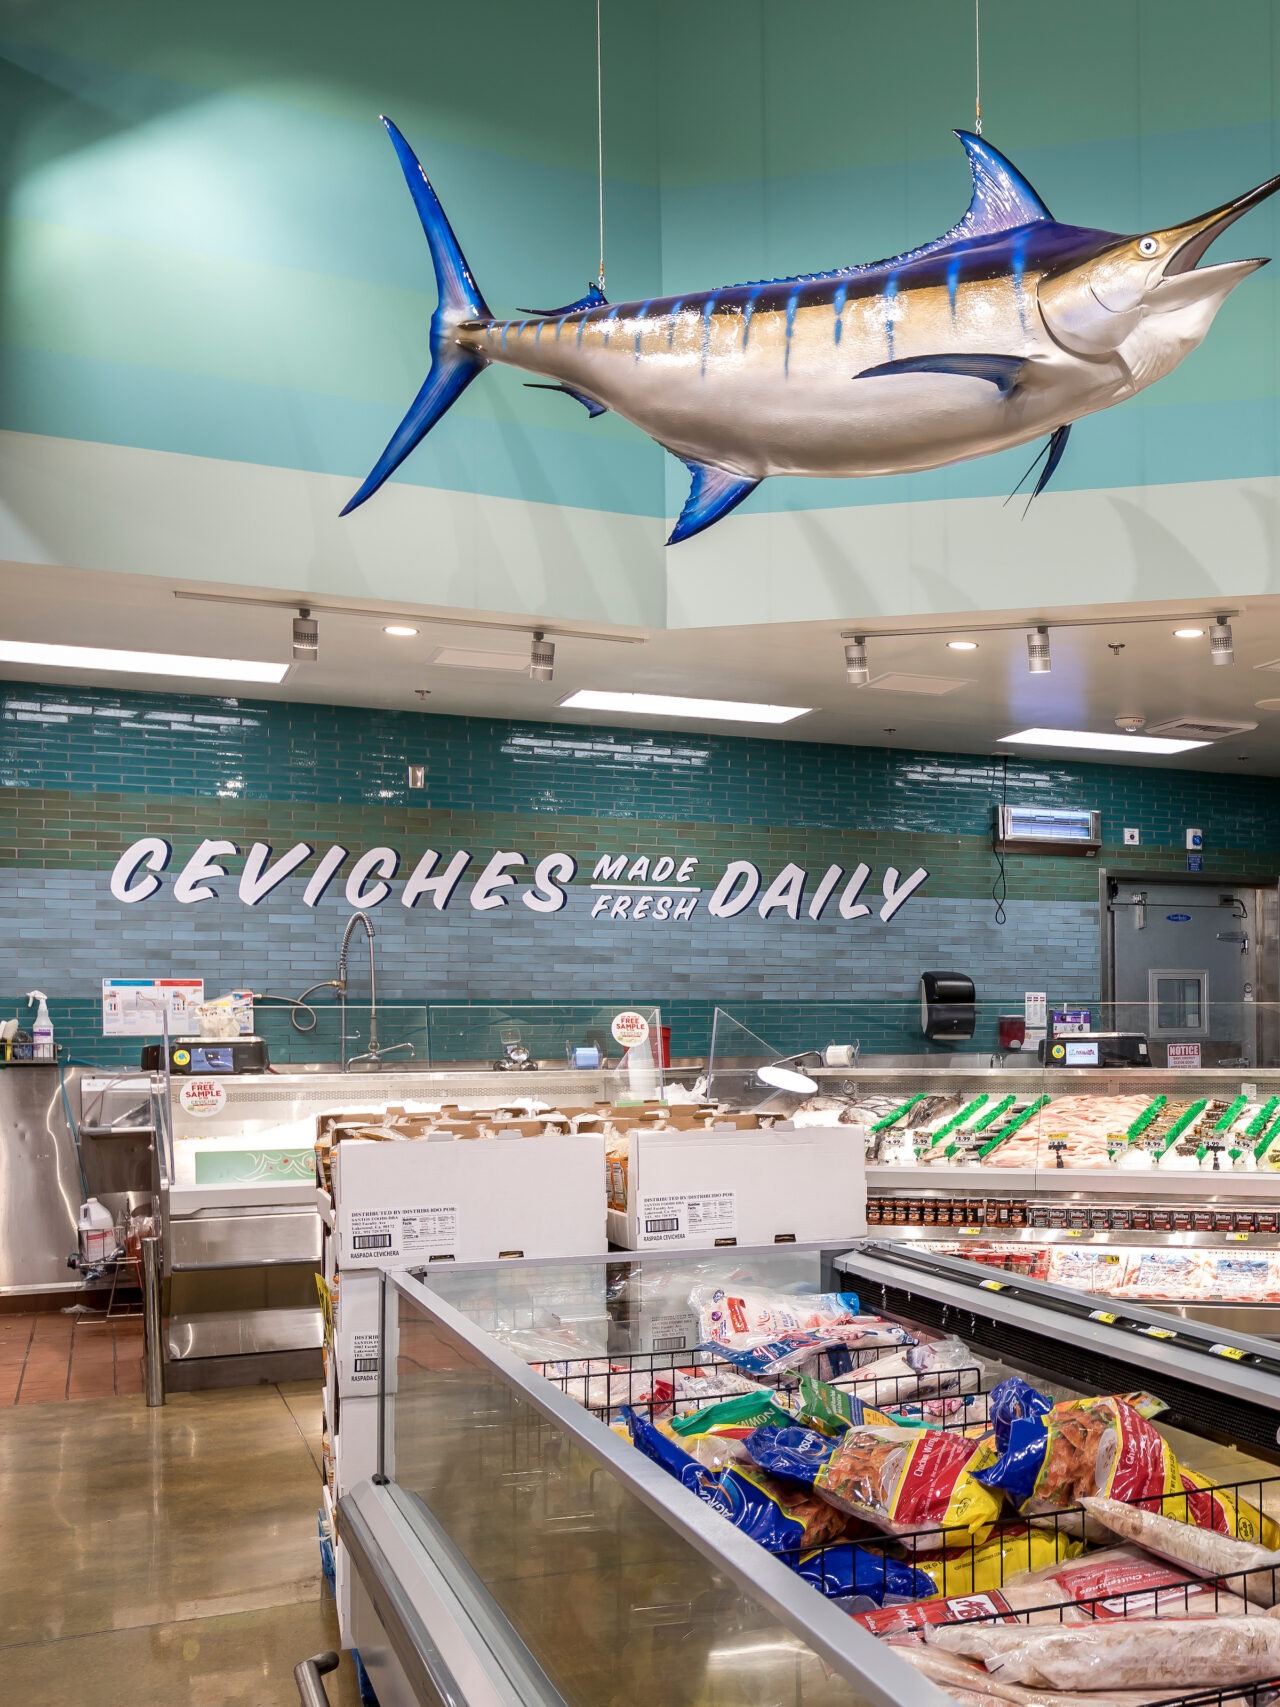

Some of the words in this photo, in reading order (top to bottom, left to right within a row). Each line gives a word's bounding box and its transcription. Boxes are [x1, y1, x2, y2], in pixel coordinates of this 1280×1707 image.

[592, 853, 699, 883] MADE
[110, 837, 577, 912] CEVICHES
[707, 860, 931, 922] DAILY
[590, 894, 699, 921] FRESH
[1170, 1046, 1199, 1056] NOTICE
[185, 1090, 222, 1098] SAMPLE
[643, 1234, 663, 1242] RASPADA
[350, 1251, 373, 1259] RASPADA
[374, 1250, 400, 1258] CEVICHERA
